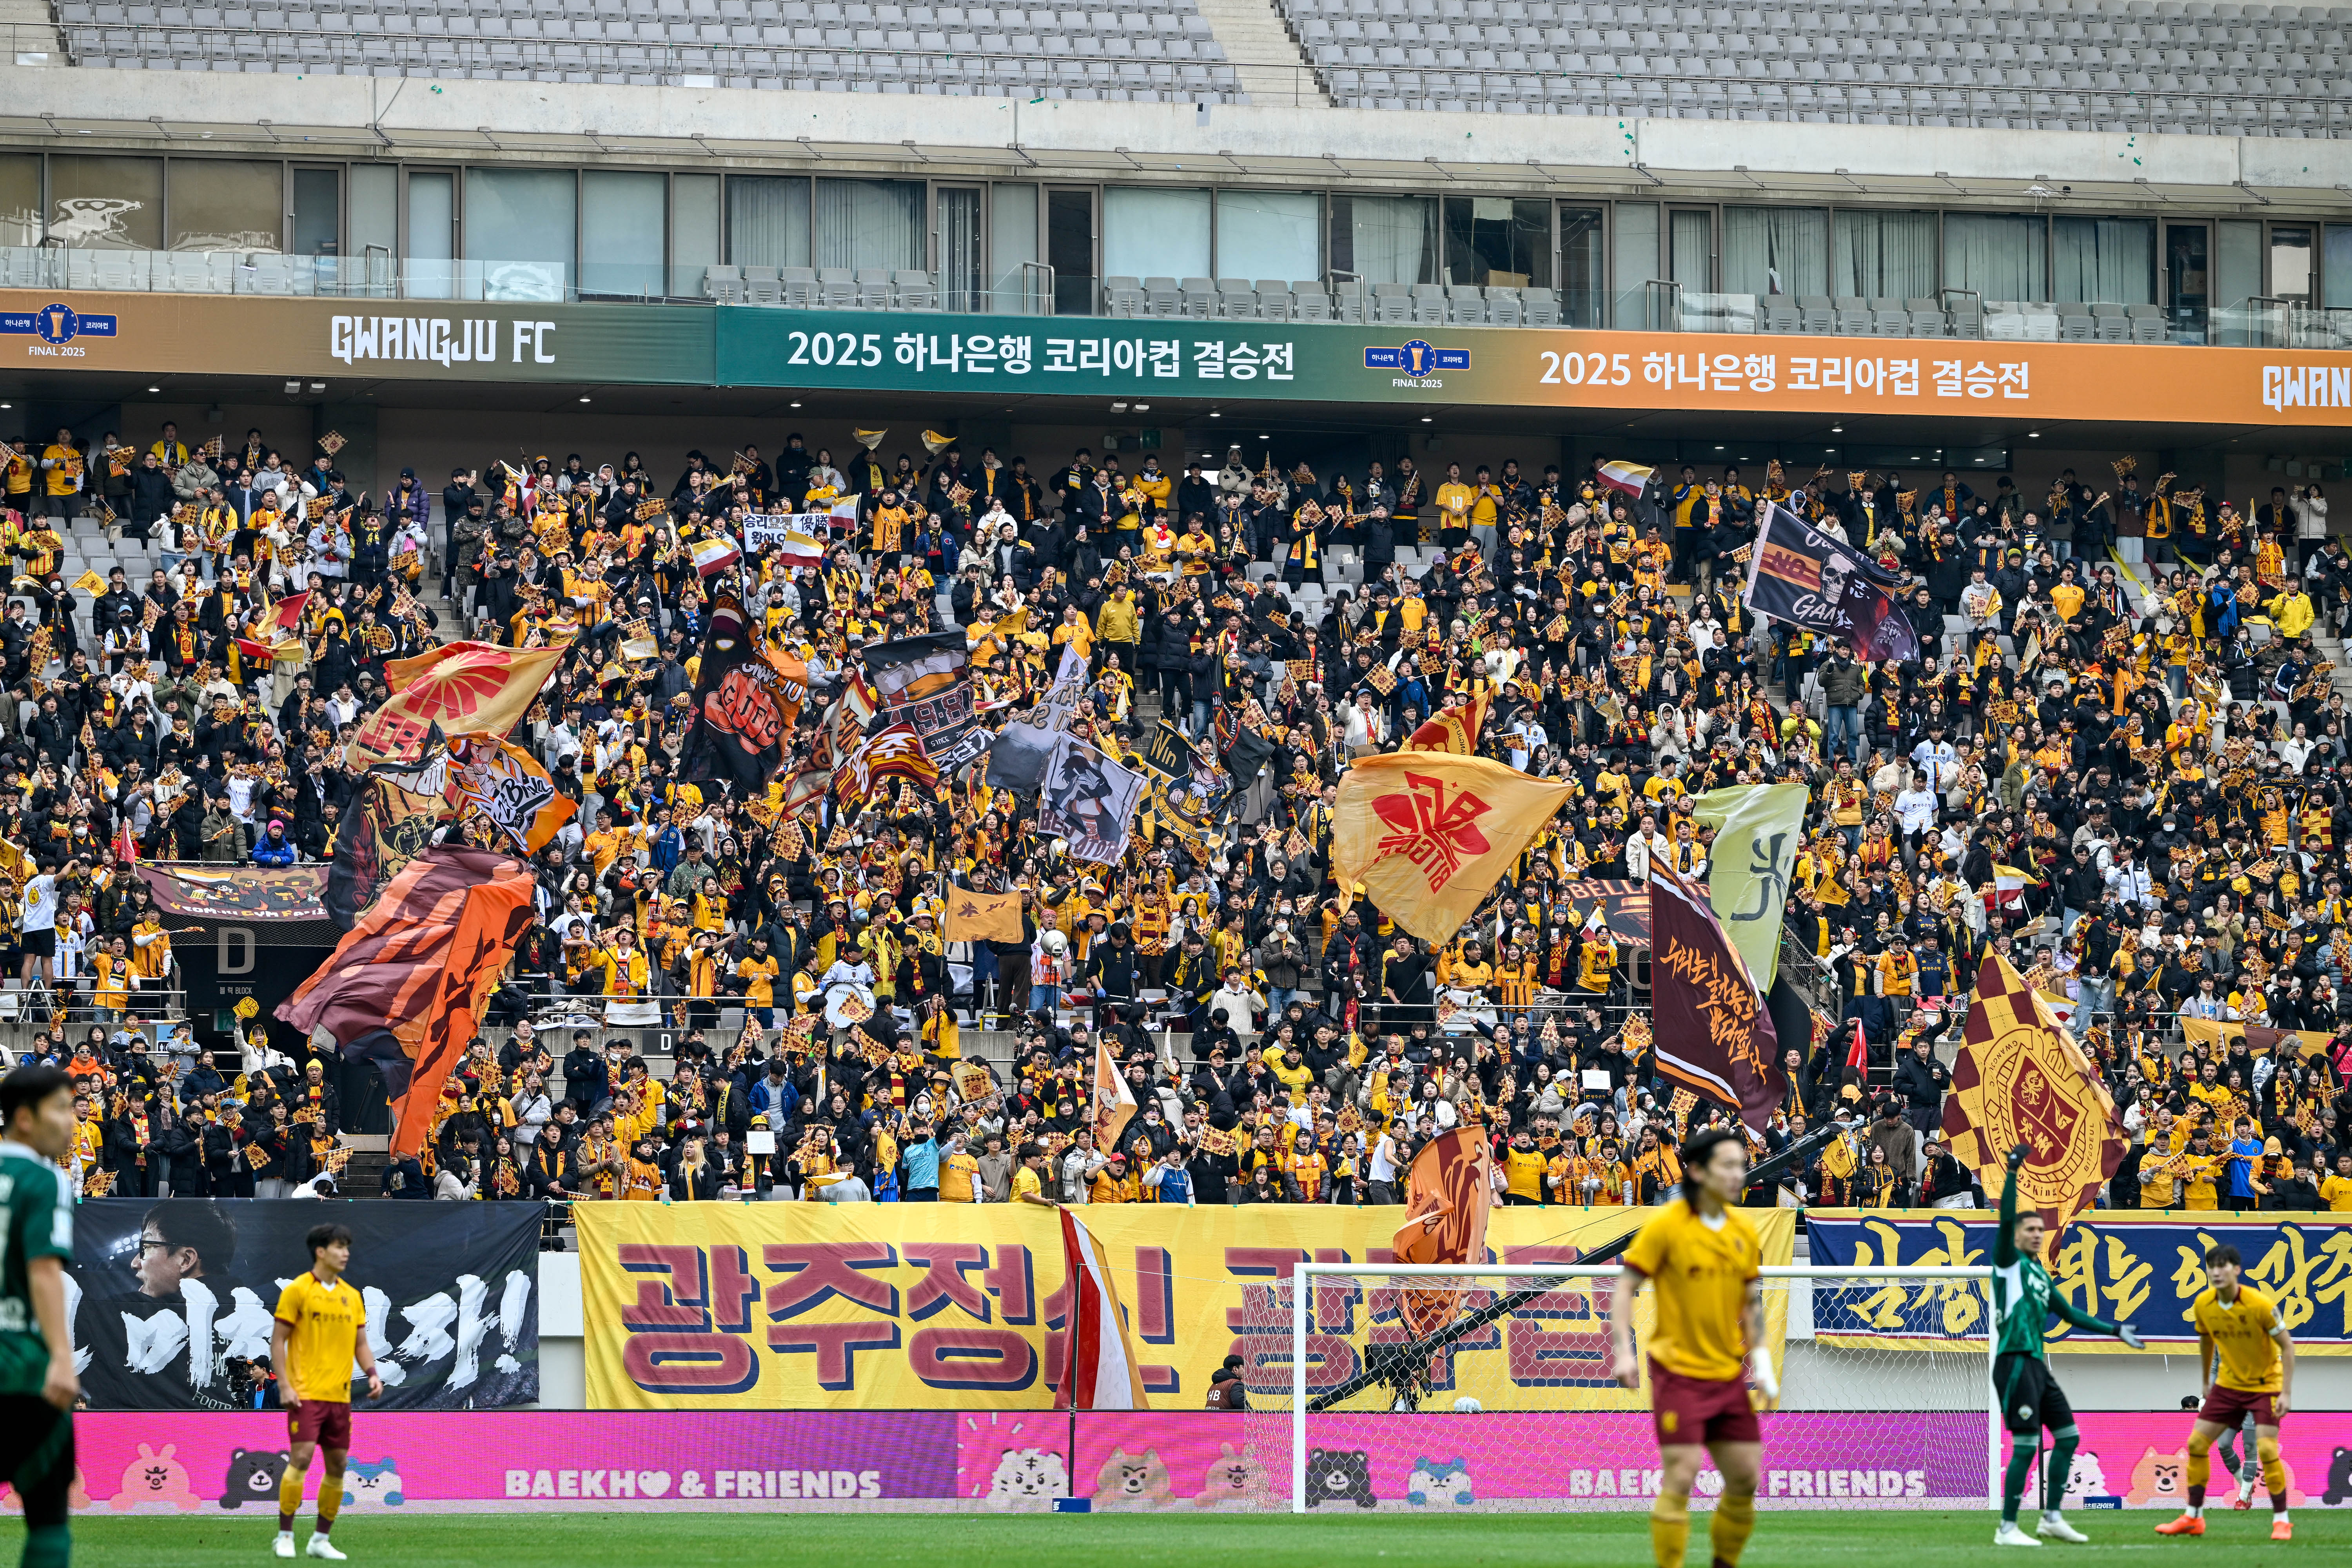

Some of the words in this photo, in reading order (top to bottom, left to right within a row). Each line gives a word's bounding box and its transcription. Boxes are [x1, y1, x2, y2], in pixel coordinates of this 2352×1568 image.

[29, 346, 58, 356] FINAL
[61, 347, 85, 357] 2025
[332, 316, 497, 368] GWANGJU
[512, 321, 556, 363] FC
[788, 332, 882, 367] 2025
[893, 332, 1033, 374] 하나은행
[1043, 338, 1180, 378] 코리아컵
[1193, 341, 1294, 381] 결승전
[1392, 379, 1419, 387] FINAL
[1421, 379, 1443, 388] 2025
[1539, 351, 1631, 386] 2025
[1642, 351, 1776, 392] 하나은행
[1787, 356, 1919, 396] 코리아컵
[1932, 360, 2029, 399] 결승전
[1451, 496, 1463, 508] 10
[1773, 550, 1807, 575] NO
[930, 735, 951, 748] SINCE
[1151, 726, 1178, 768] Win
[660, 1034, 671, 1051] D
[907, 1152, 931, 1160] GWANGJU
[2083, 1123, 2094, 1172] BITGOEUL
[955, 1165, 973, 1173] 광주은행
[617, 1242, 1181, 1395] 광주정신
[1225, 1247, 1764, 1391] 광주답
[680, 1470, 708, 1498] &
[715, 1470, 881, 1498] FRIENDS
[1768, 1470, 1926, 1497] FRIENDS
